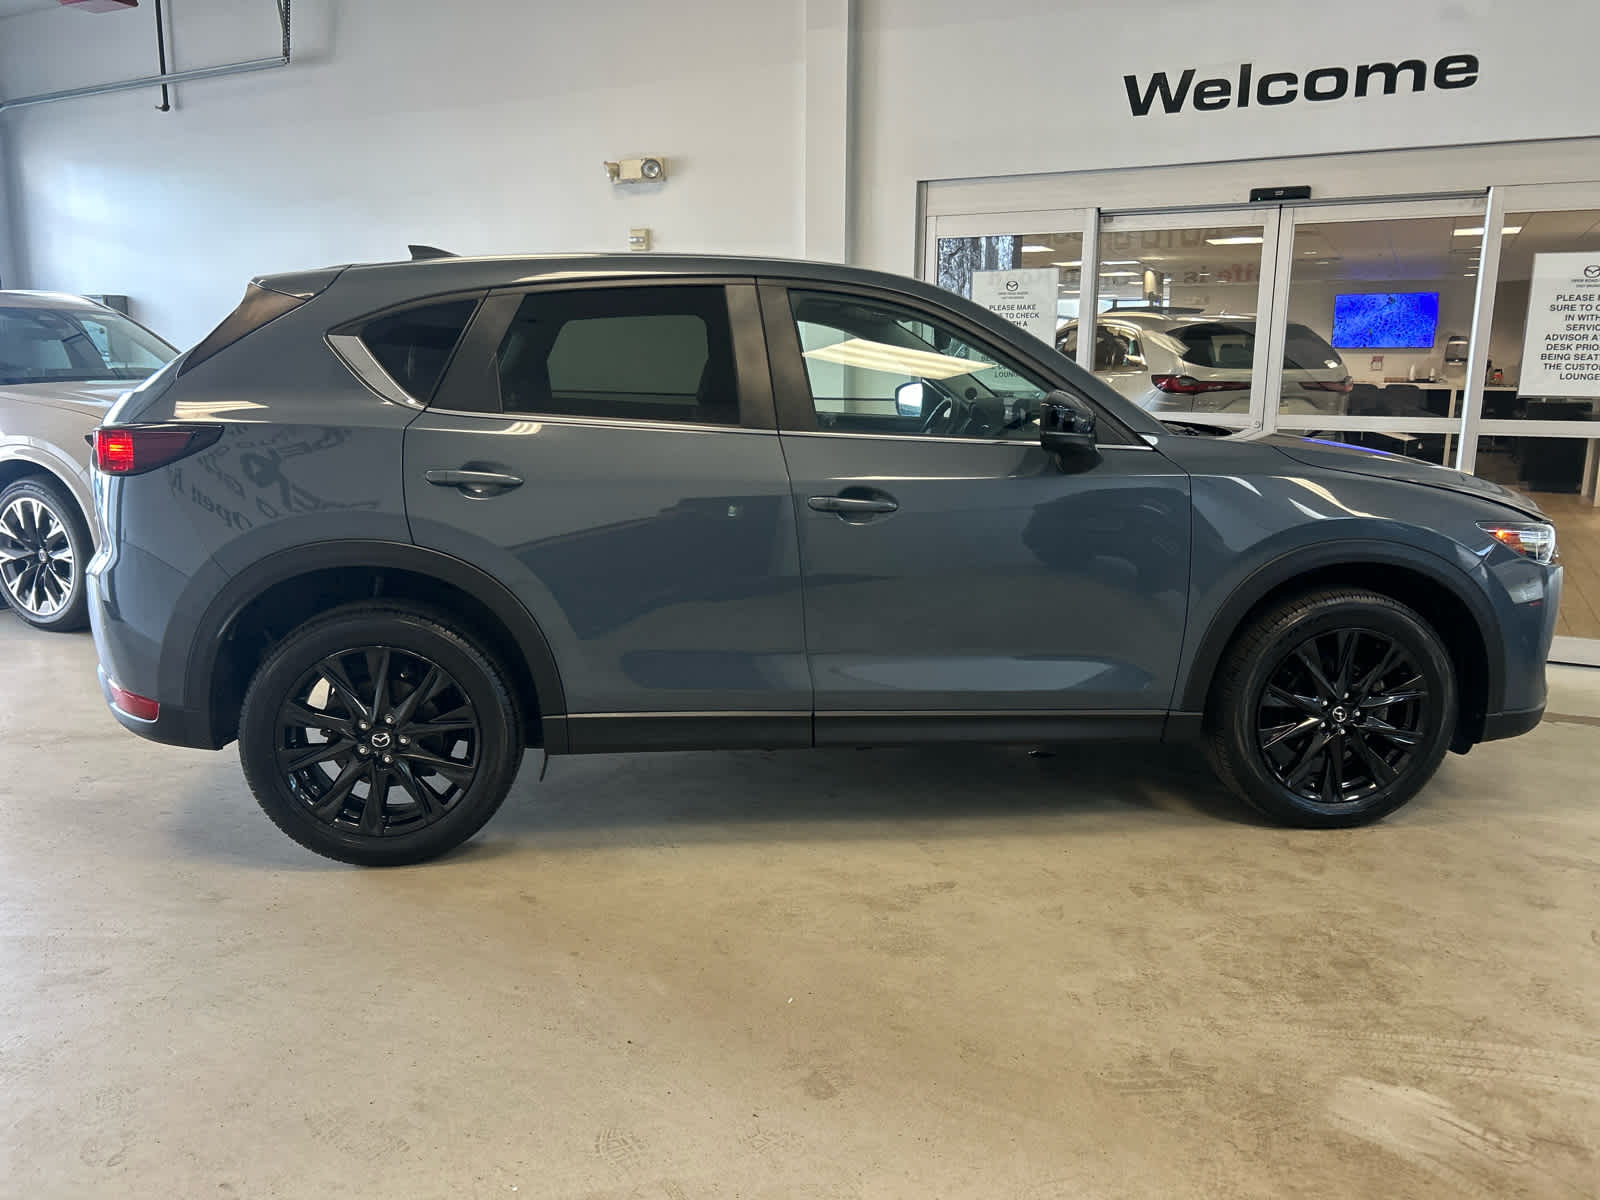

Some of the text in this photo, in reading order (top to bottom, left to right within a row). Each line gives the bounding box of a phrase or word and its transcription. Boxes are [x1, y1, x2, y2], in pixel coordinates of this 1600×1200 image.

[1124, 54, 1479, 116] Welcome
[1546, 343, 1600, 351] DESK PRIO
[1565, 363, 1600, 371] CUSTO
[1559, 373, 1600, 381] LOUNGE
